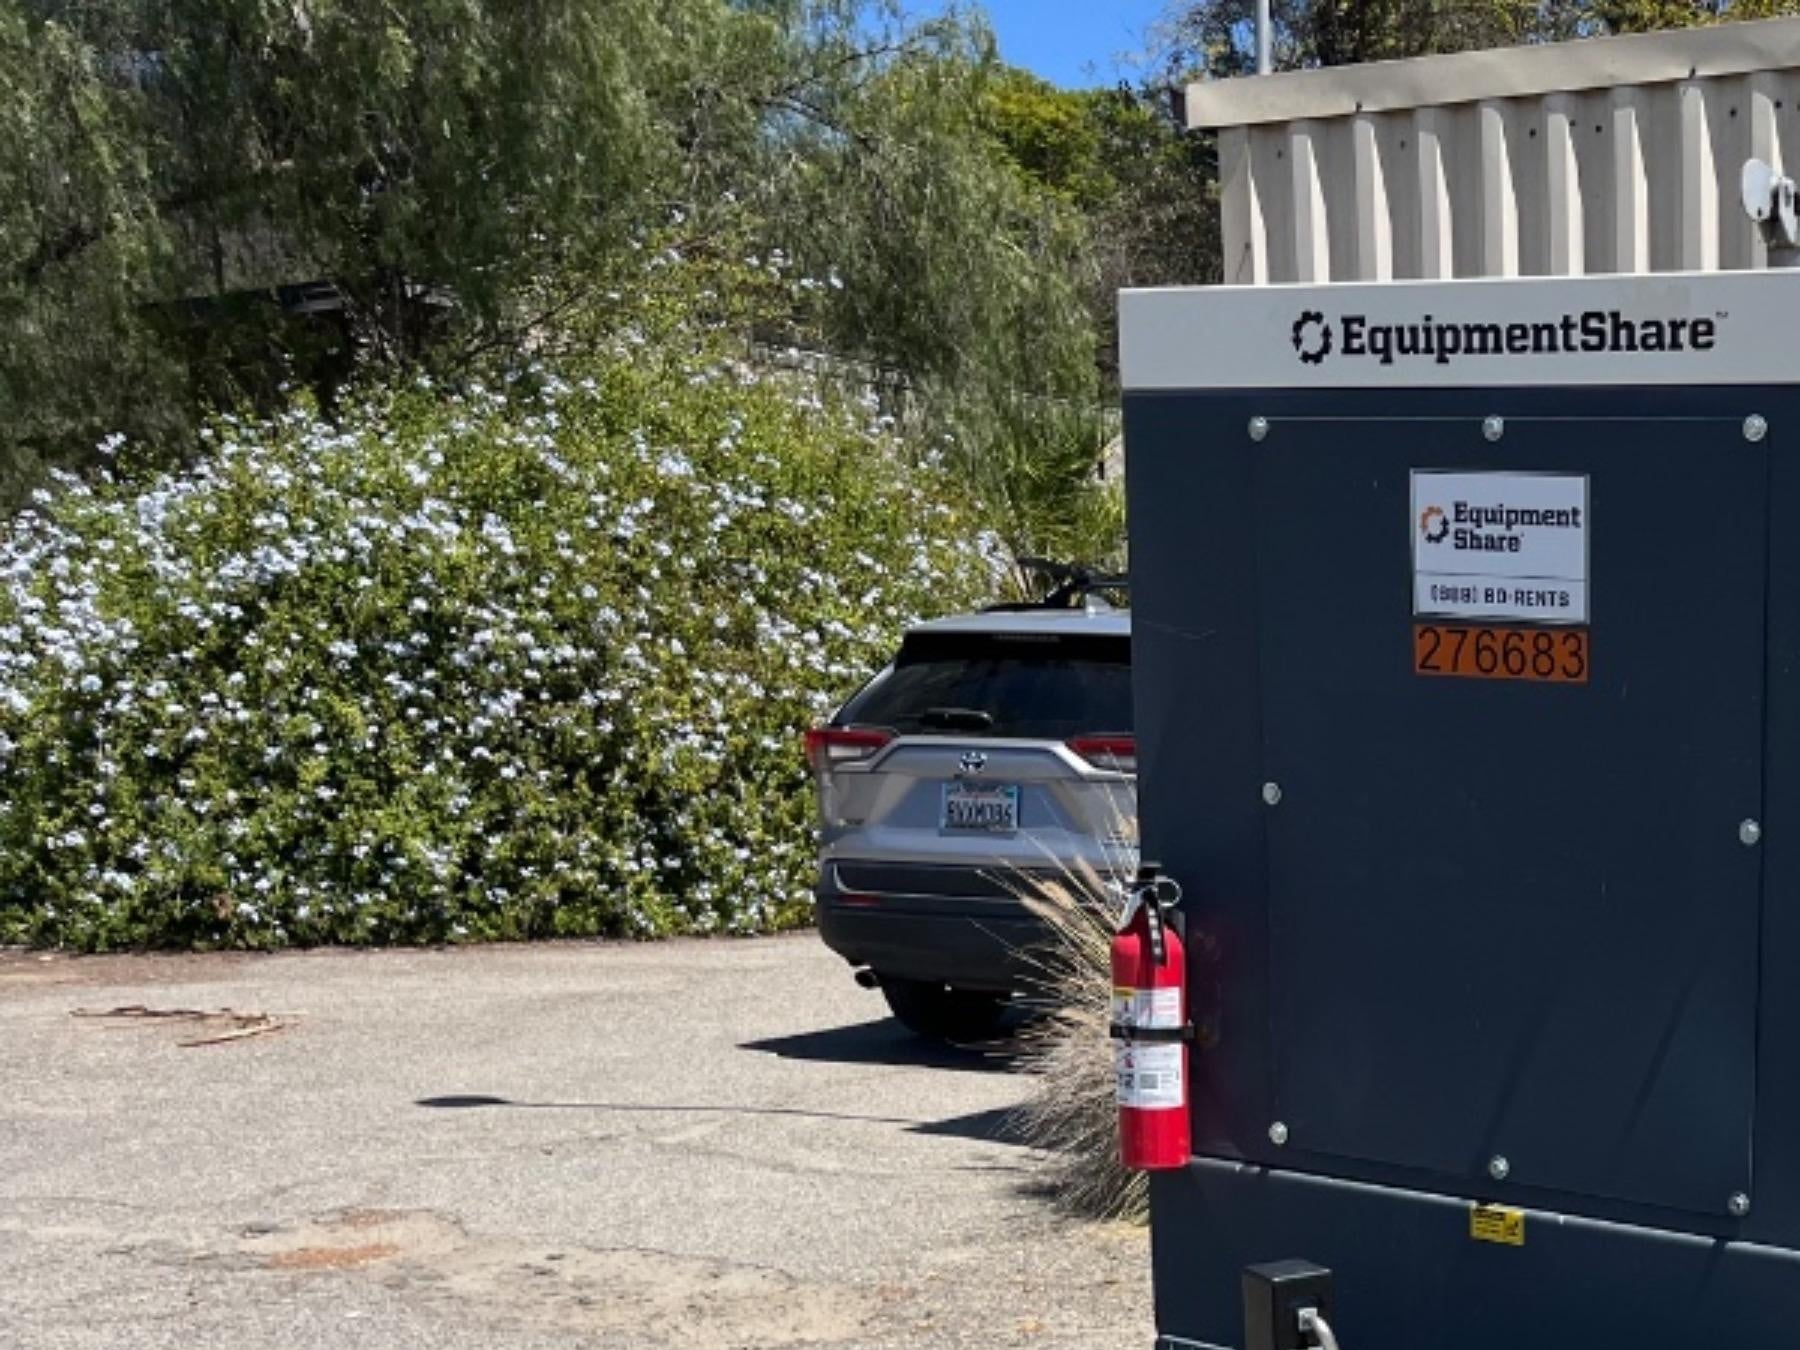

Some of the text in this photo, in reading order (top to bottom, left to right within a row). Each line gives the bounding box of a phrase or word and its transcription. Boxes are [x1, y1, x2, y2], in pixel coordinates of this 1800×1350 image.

[1453, 501, 1581, 531] Equipment
[1453, 528, 1522, 553] Share
[1417, 626, 1586, 678] 276683
